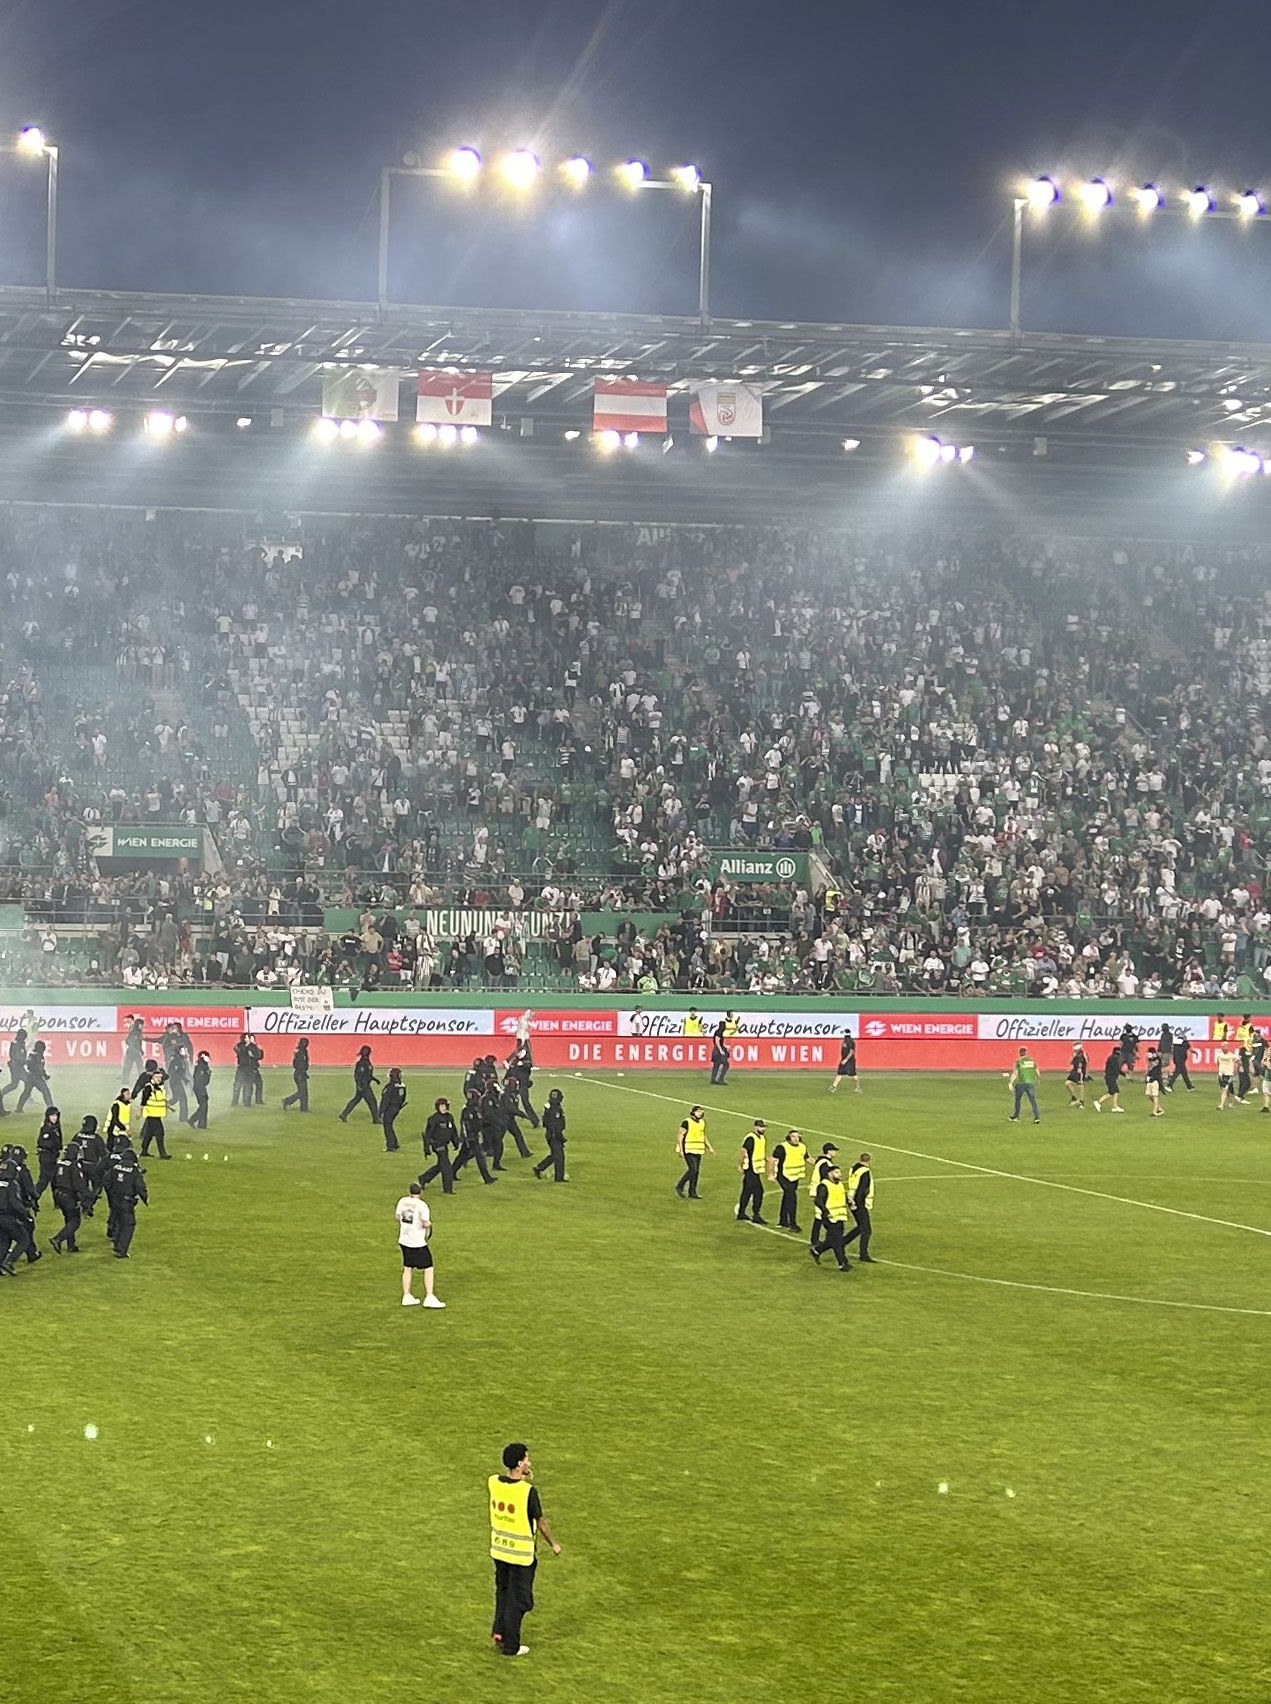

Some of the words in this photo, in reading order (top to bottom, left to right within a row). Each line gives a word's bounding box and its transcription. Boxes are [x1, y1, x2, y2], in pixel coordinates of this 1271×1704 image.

[117, 838, 147, 847] WIEN
[150, 838, 198, 848] ENERGIE
[720, 859, 773, 874] Allianz
[151, 1016, 185, 1027] WIEN
[188, 1017, 239, 1028] ENERGIE
[264, 1011, 349, 1033] Offizieller
[354, 1011, 479, 1034] Hauptsponsor.
[529, 1020, 560, 1031] WIEN
[562, 1020, 612, 1031] ENERGIE
[736, 1016, 844, 1038] auptsponsor.
[890, 1023, 922, 1034] WIEN
[924, 1024, 974, 1035] ENERGIE
[996, 1018, 1075, 1040] Offizieller
[66, 1040, 108, 1057] VON
[569, 1043, 602, 1060] DIE
[614, 1043, 707, 1061] ENERGIE
[770, 1046, 824, 1062] WIEN
